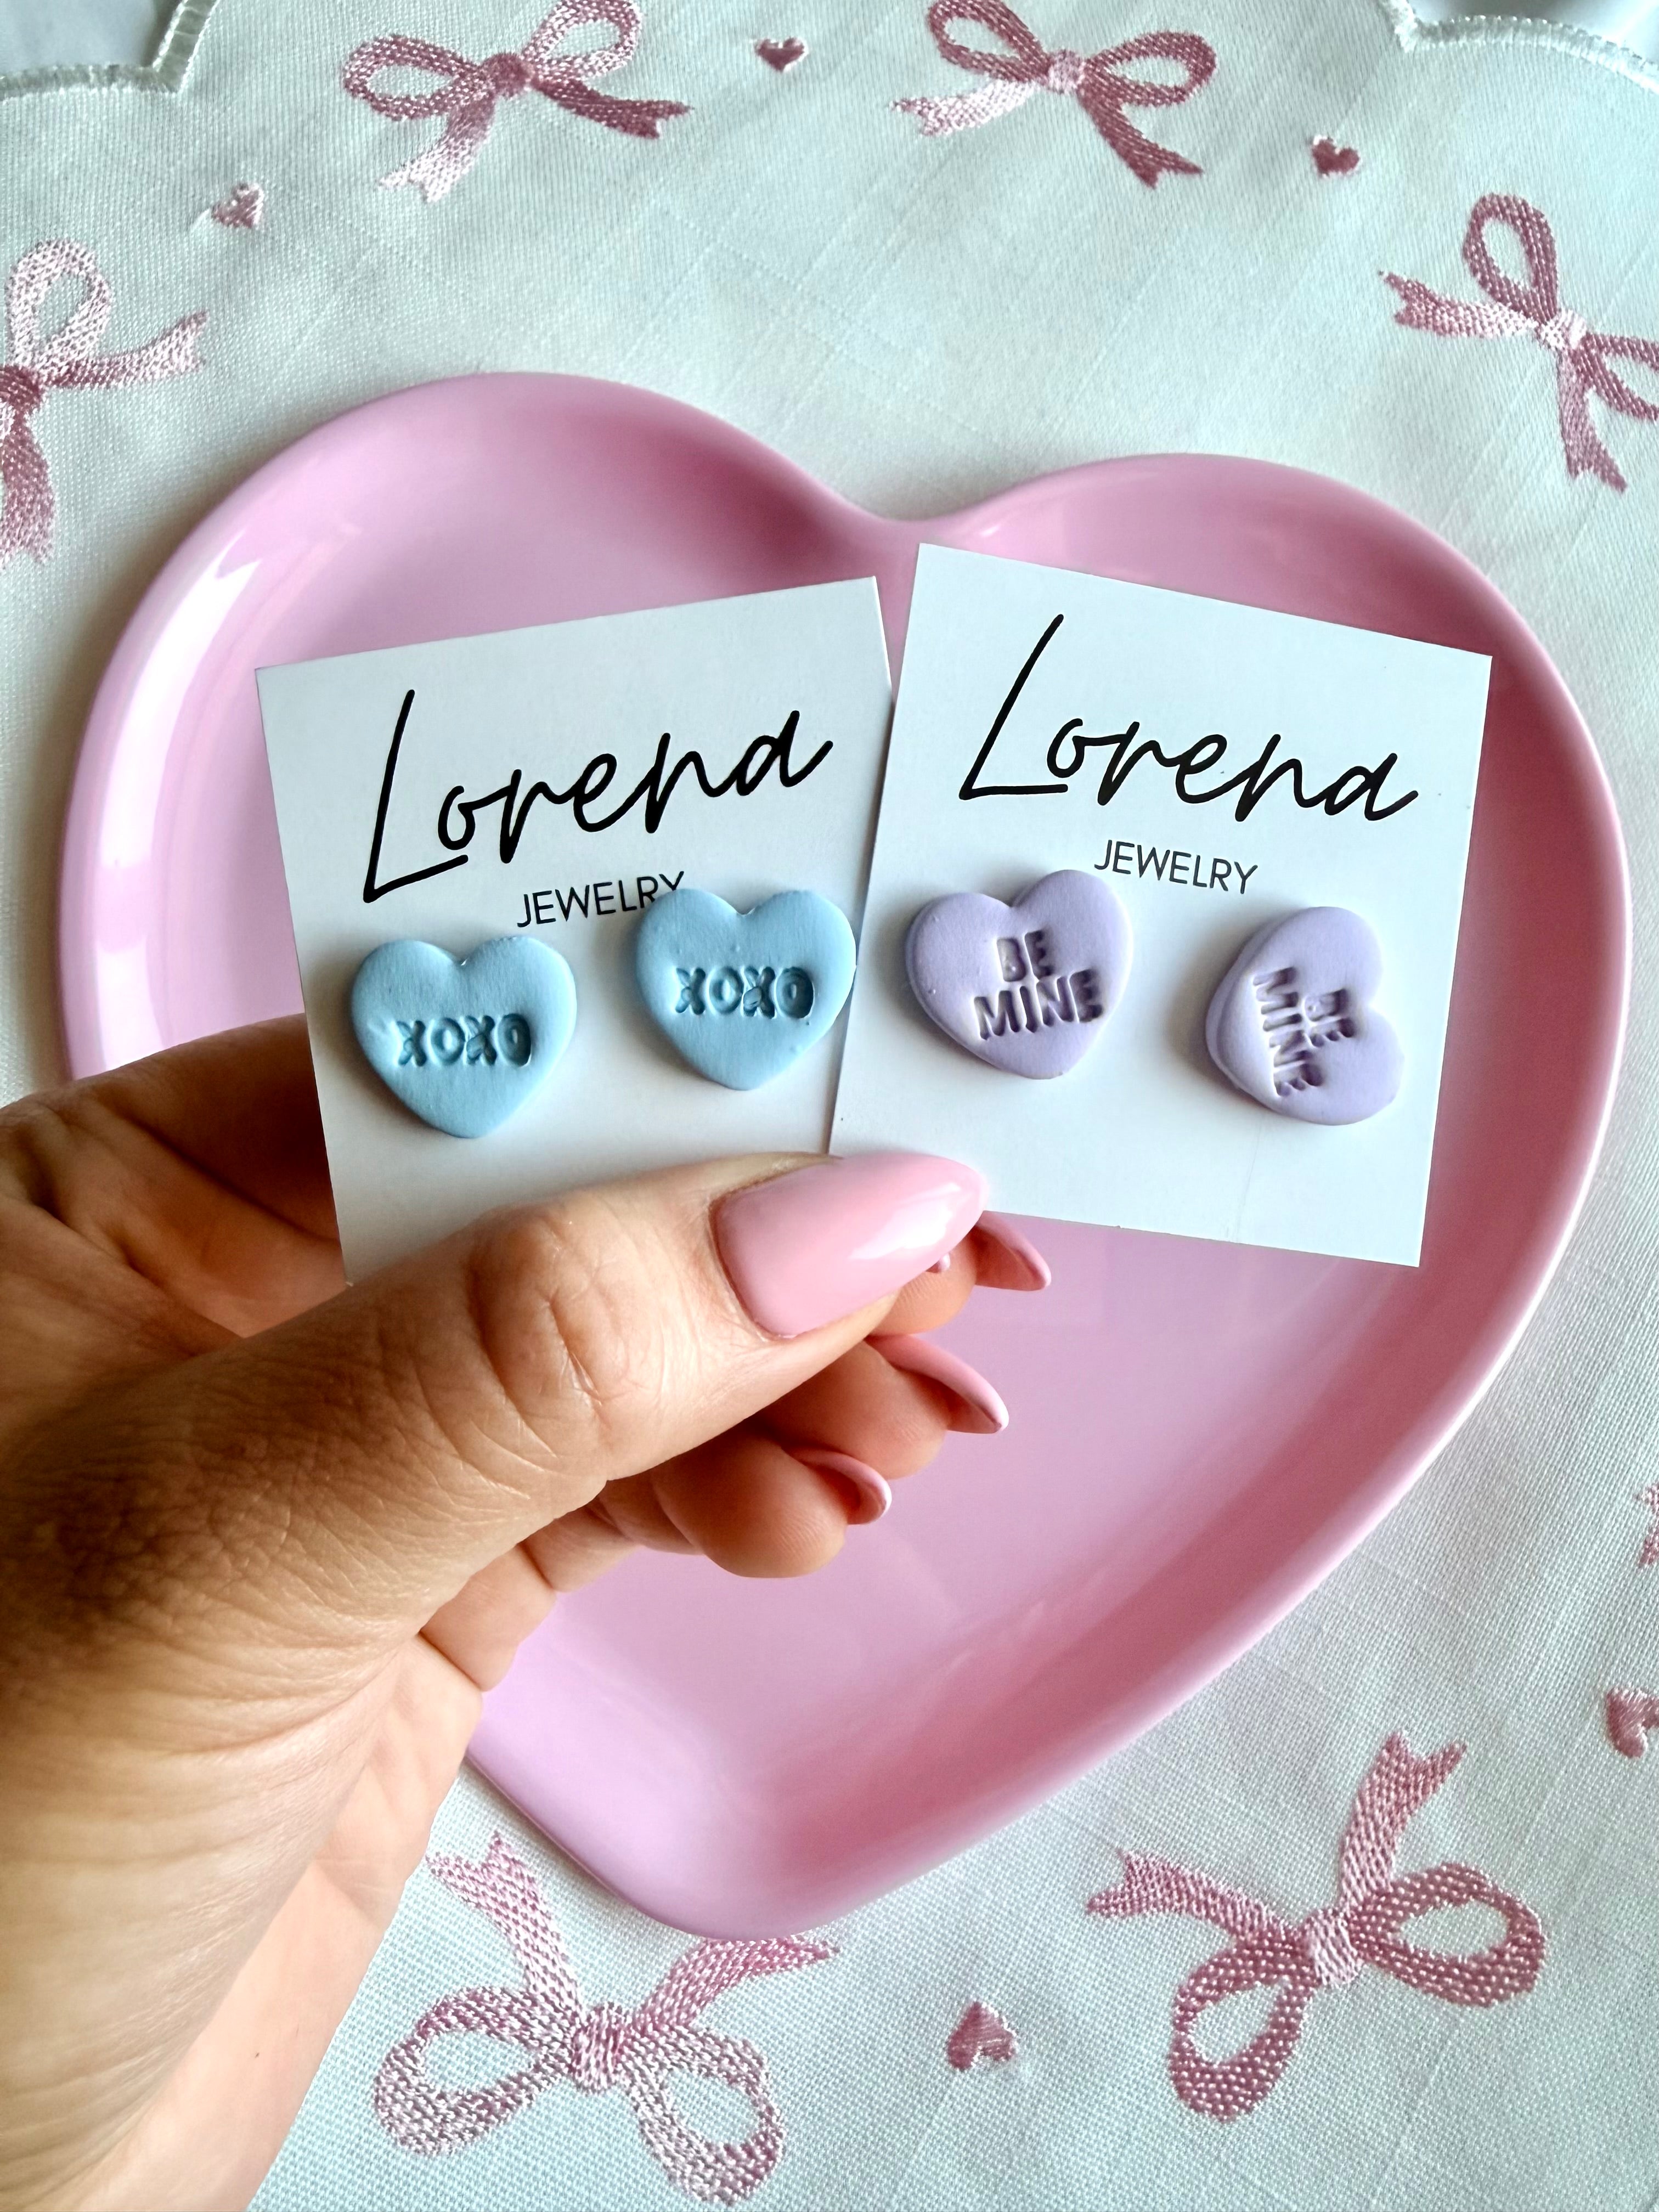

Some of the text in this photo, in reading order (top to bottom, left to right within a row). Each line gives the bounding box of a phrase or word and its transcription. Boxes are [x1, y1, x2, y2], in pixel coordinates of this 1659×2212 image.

[1094, 839, 1258, 894] JEWELRY
[517, 871, 684, 928] JEWELRY
[996, 929, 1053, 982] BE
[675, 966, 814, 1019] XOXO
[973, 968, 1103, 1040] MINE
[1304, 988, 1356, 1048] BE
[396, 1013, 532, 1068] XOXO
[1252, 966, 1323, 1097] MINE
